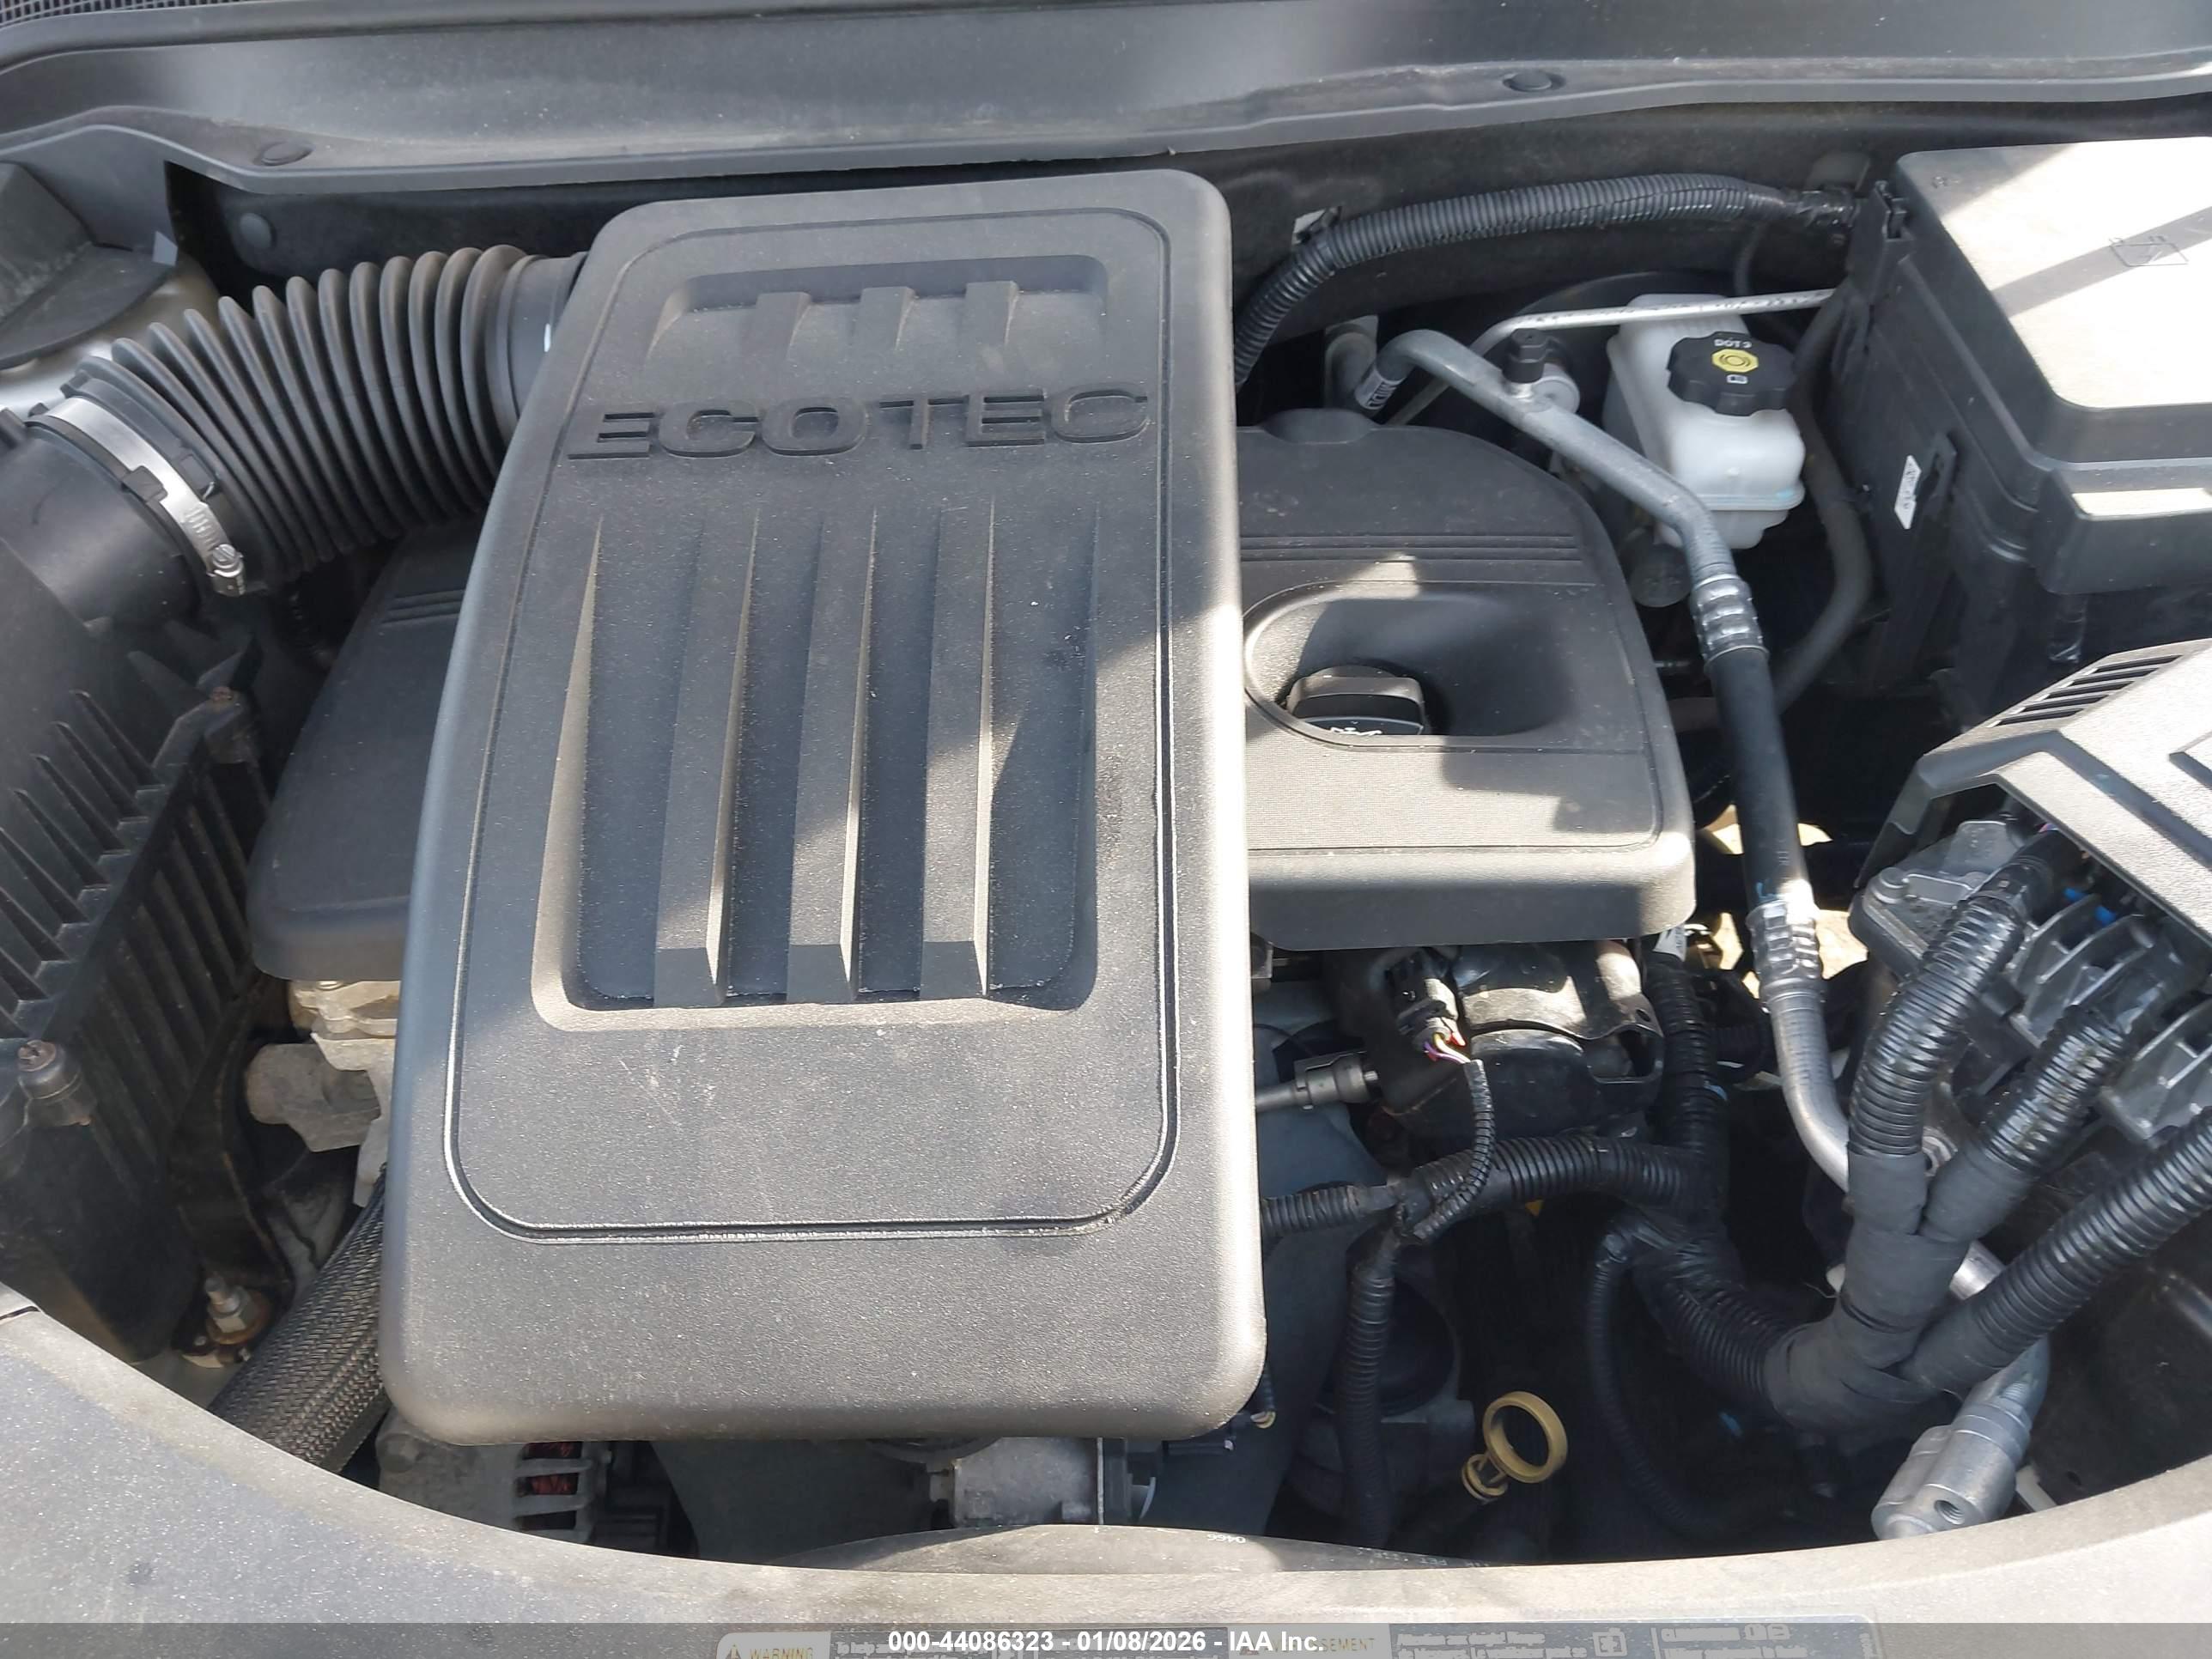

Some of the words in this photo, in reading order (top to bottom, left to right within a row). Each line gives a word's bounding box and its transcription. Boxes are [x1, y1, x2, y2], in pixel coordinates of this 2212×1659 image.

[1714, 338, 1741, 348] DOT
[567, 381, 1149, 460] ECOTEC
[750, 1647, 814, 1659] WARNING
